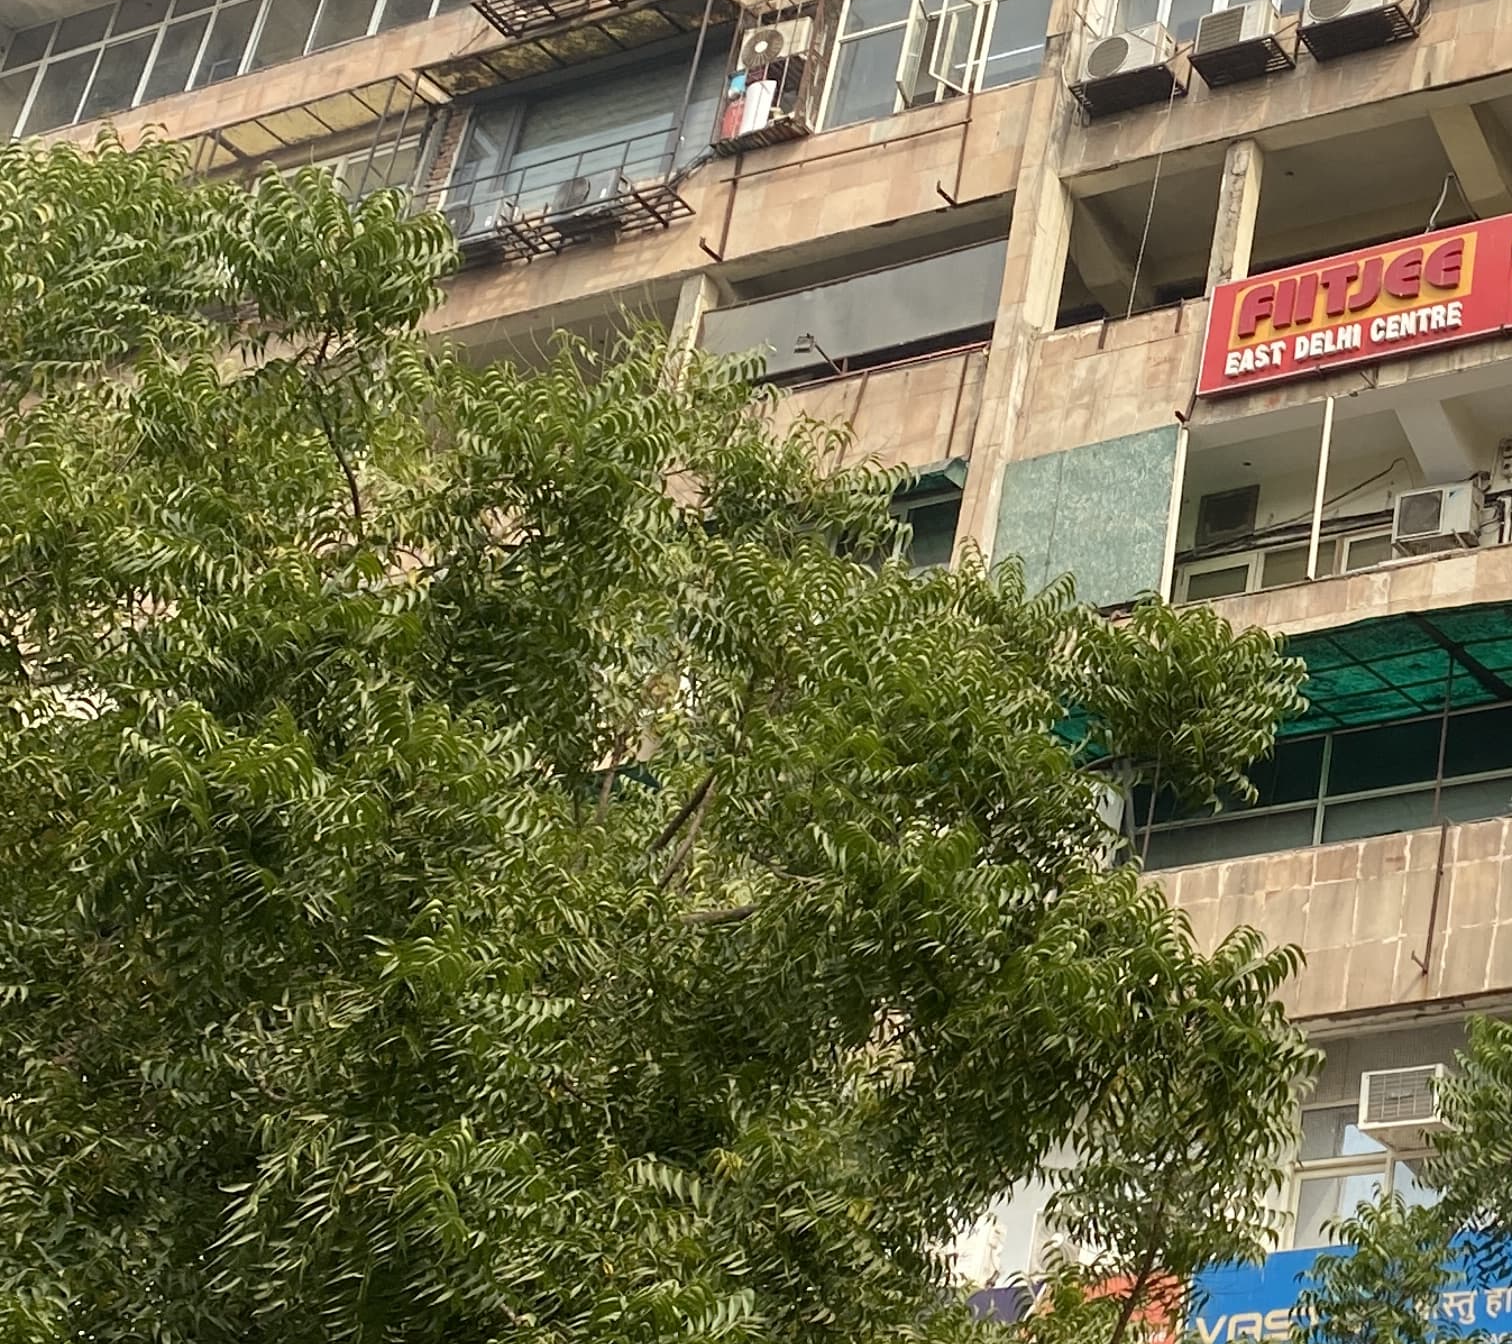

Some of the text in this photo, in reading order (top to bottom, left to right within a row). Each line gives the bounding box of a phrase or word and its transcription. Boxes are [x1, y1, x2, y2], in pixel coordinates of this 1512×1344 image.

[1237, 236, 1463, 339] FIITJEE
[1225, 301, 1463, 377] EAST DELHI CENTRE
